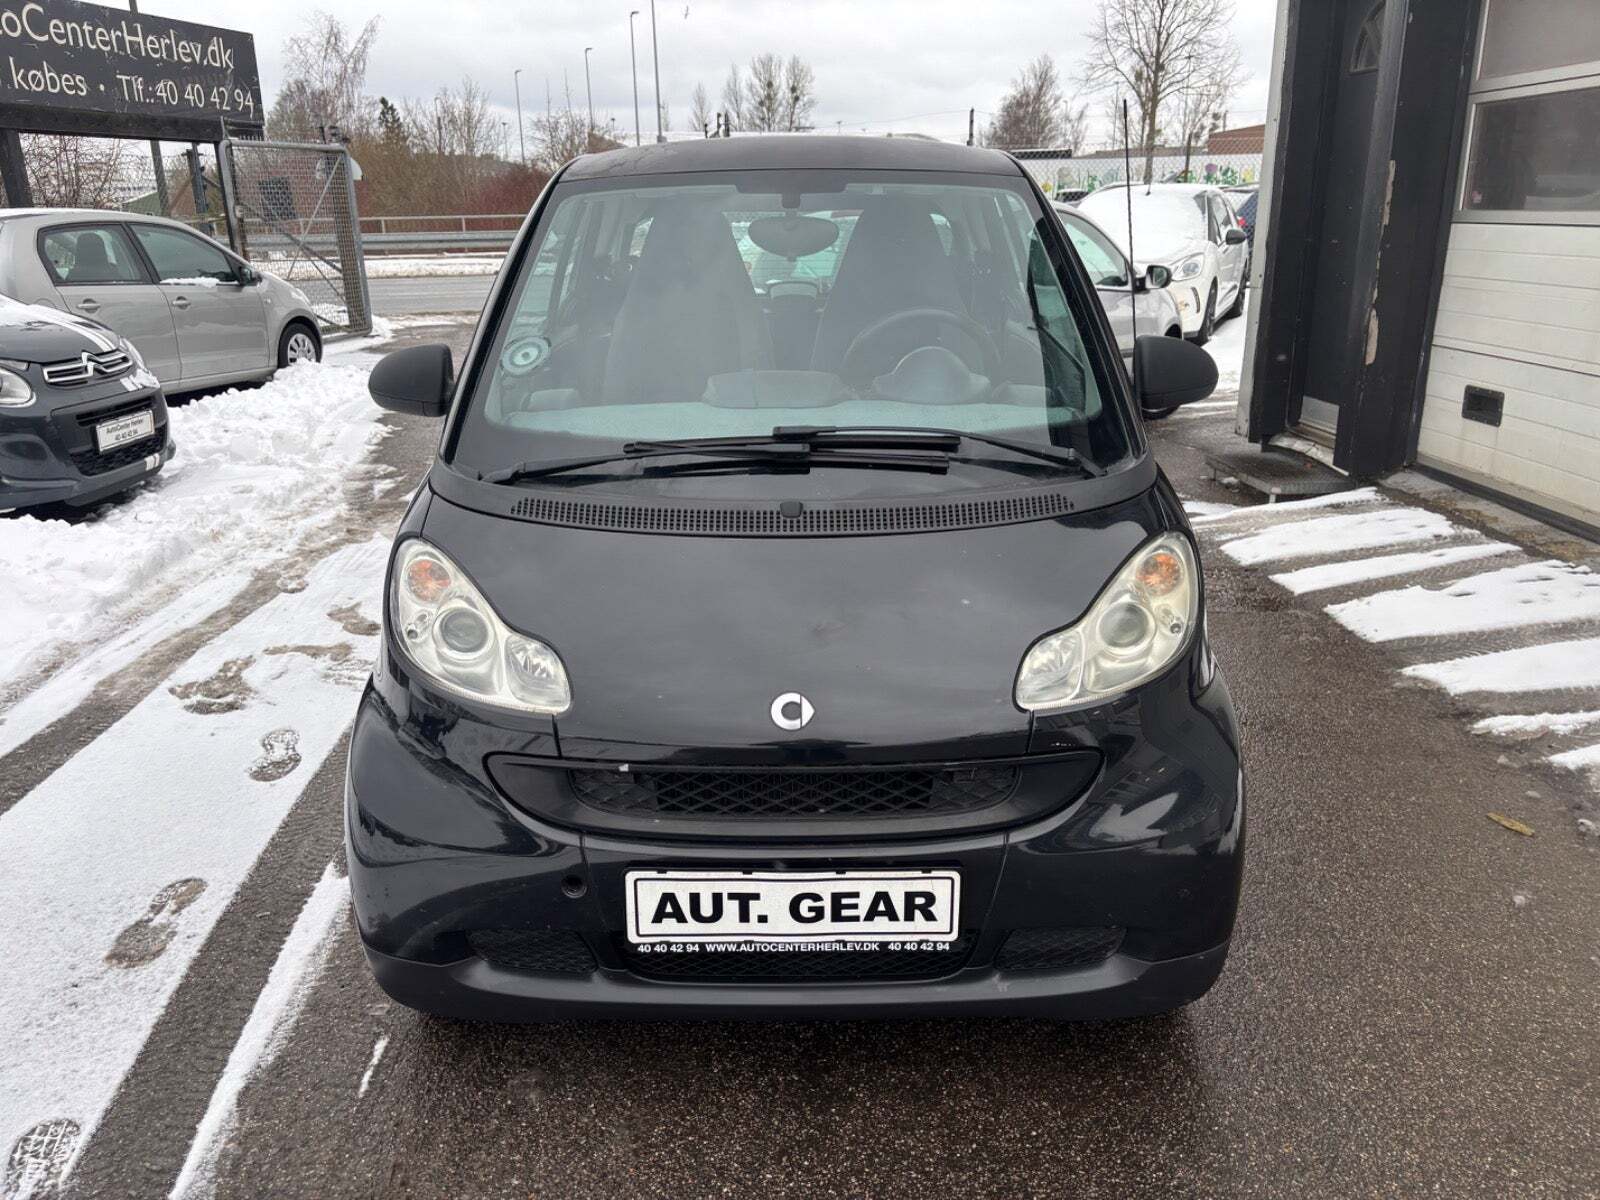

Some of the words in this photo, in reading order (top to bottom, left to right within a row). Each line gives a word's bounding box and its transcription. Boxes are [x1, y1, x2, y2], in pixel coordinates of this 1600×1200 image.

[0, 3, 234, 70] oCenterHerlev.dk
[9, 56, 87, 96] købes
[184, 83, 205, 108] 40
[210, 86, 231, 111] 42
[234, 88, 254, 119] 94
[651, 892, 768, 923] AUT.
[789, 891, 938, 923] GEAR
[637, 944, 651, 953] 40
[654, 944, 668, 953] 40
[670, 944, 684, 953] 42
[686, 943, 700, 953] 94
[705, 942, 880, 952] WWW.AUTOCENTERHERLEV.DK
[888, 942, 901, 951] 40
[904, 942, 918, 951] 40
[920, 942, 934, 951] 42
[936, 942, 950, 951] 94
